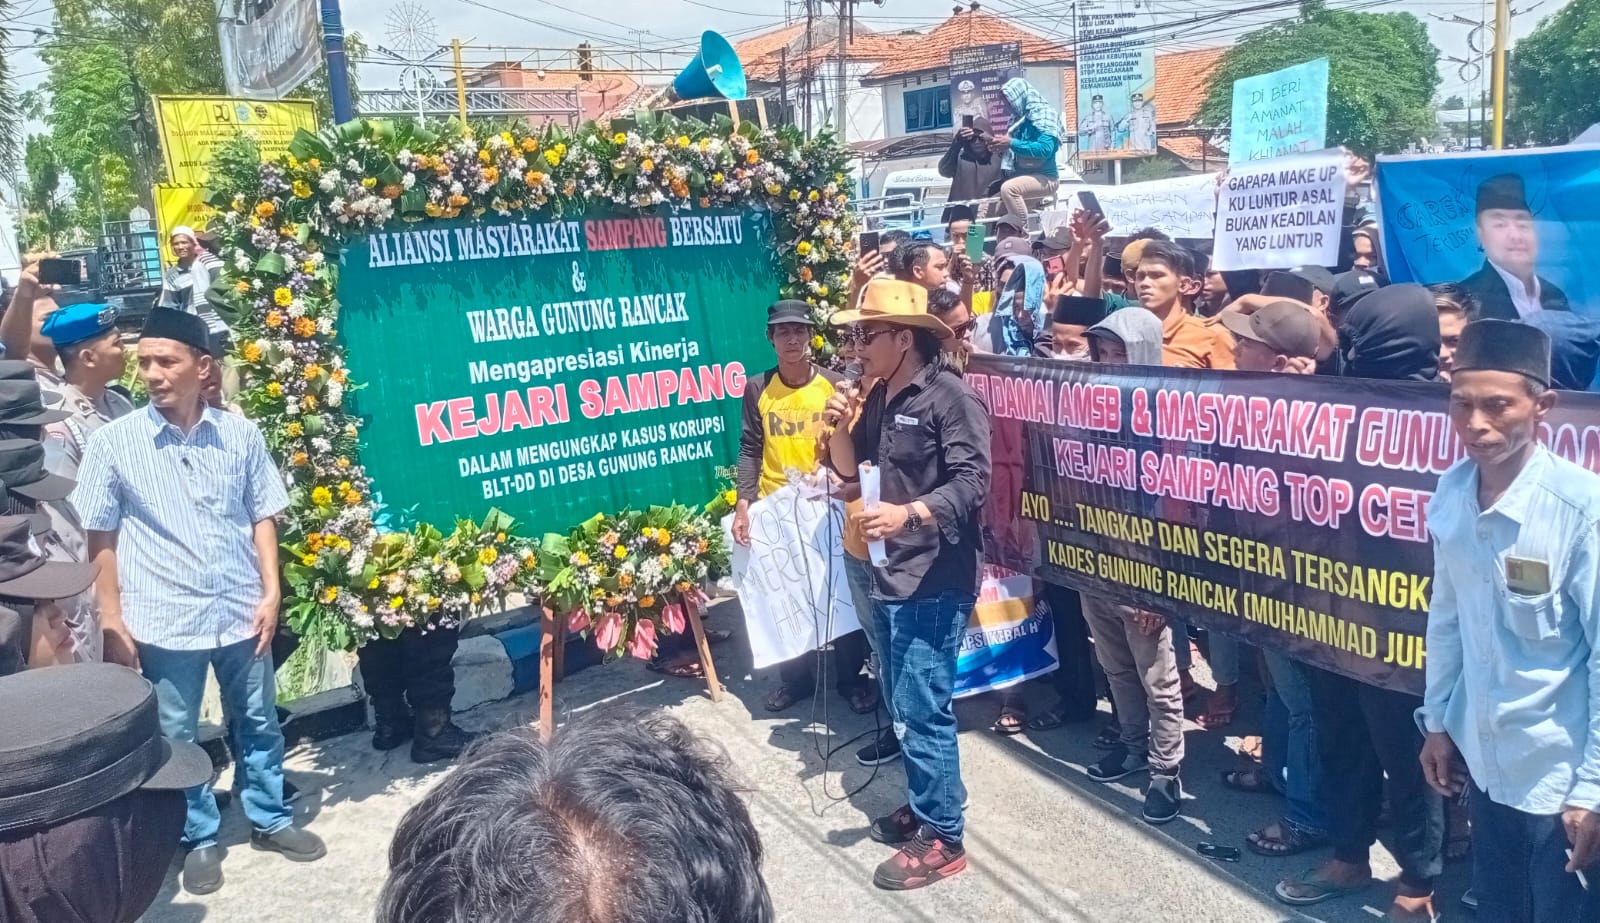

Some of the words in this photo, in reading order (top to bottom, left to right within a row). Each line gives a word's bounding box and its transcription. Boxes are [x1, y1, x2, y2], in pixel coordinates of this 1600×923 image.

[1250, 100, 1304, 123] AMANAT
[1256, 120, 1303, 142] MALAH
[1228, 172, 1276, 191] GAPAPA
[1279, 167, 1315, 186] MAKE
[1319, 165, 1338, 182] UP
[1228, 195, 1246, 212] KU
[1249, 190, 1298, 210] LUNTUR
[1302, 187, 1336, 205] ASAL
[369, 229, 453, 268] ALIANSI
[454, 221, 580, 261] MASYARAKAT
[584, 217, 667, 251] SAMPANG
[669, 215, 743, 247] BERSATU
[1225, 214, 1269, 232] BUKAN
[1271, 210, 1336, 229] KEADILAN
[1235, 235, 1267, 252] YANG
[1269, 232, 1323, 250] LUNTUR
[571, 260, 587, 293] &
[466, 306, 540, 343] WARGA
[540, 298, 617, 336] GUNUNG
[619, 292, 690, 328] RANCAK
[468, 344, 625, 385] Mengapresiasi
[629, 337, 700, 364] Kinerja
[414, 383, 571, 447] KEJARI
[578, 361, 747, 420] SAMPANG
[990, 375, 1055, 425] DAMAI
[1057, 381, 1122, 433] AMSB
[1131, 387, 1154, 436] &
[1155, 388, 1357, 462] MASYARAKAT
[1356, 406, 1468, 475] GUNU
[458, 449, 514, 478] DALAM
[516, 432, 618, 467] MENGUNGKAP
[621, 423, 667, 448] KASUS
[669, 415, 726, 441] KORUPSI
[481, 472, 536, 500] BLT-DD
[539, 467, 556, 488] DI
[558, 461, 596, 485] DESA
[598, 450, 657, 477] GUNUNG
[659, 440, 714, 465] RANCAK
[1053, 437, 1137, 491] KEJARI
[1140, 450, 1280, 517] SAMPANG
[1284, 471, 1354, 530] TOP
[1020, 491, 1049, 522] AYO
[1075, 502, 1154, 547] TANGKAP
[1158, 521, 1200, 558] DAN
[1203, 530, 1287, 580] SEGERA
[1291, 549, 1431, 612] TERSANGK
[1047, 539, 1096, 576] KADES
[1097, 553, 1162, 594] GUNUNG
[1166, 570, 1239, 617] RANCAK
[988, 626, 1028, 646] KEBAL
